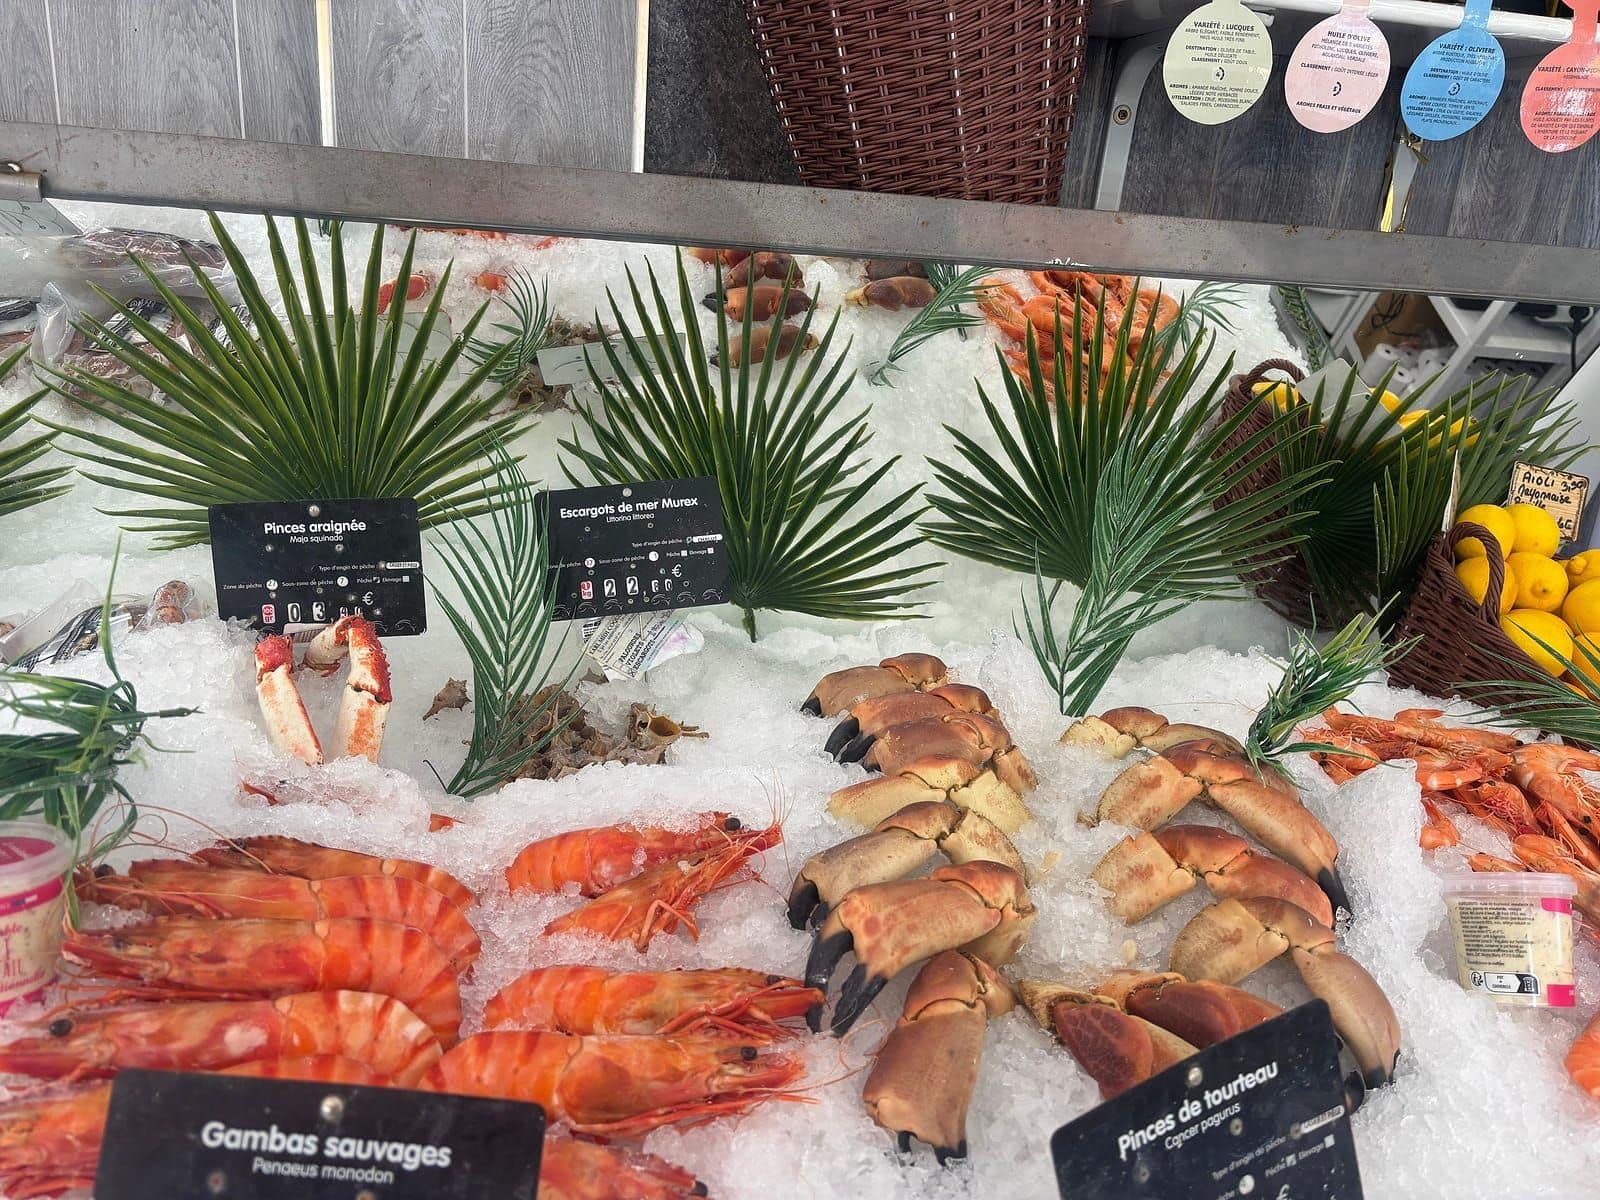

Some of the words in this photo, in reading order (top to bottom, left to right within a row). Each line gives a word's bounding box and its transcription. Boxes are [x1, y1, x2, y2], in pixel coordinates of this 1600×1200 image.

[1194, 21, 1220, 29] VARIÉTÉ
[1226, 24, 1255, 32] LUCQUES
[1328, 31, 1346, 39] HUILE
[1347, 34, 1371, 42] D'OLIVE
[1439, 43, 1464, 51] VARIÉTÉ
[1300, 62, 1331, 71] CLASSEMENT
[1522, 471, 1555, 487] AIOLI
[560, 503, 615, 520] Escargots
[617, 501, 633, 515] de
[636, 500, 658, 512] mer
[661, 497, 699, 510] Murex
[606, 514, 631, 523] Littorina
[632, 512, 655, 521] littorea
[264, 522, 306, 535] Pinces
[308, 518, 366, 535] araignée
[290, 535, 309, 544] Maja
[310, 534, 344, 544] squinado
[319, 564, 331, 572] Type
[672, 563, 682, 578] €
[223, 583, 237, 591] Zone
[309, 578, 317, 586] de
[317, 577, 334, 587] pêche
[362, 590, 374, 606] €
[1117, 1113, 1177, 1162] Pinces
[1178, 1098, 1202, 1123] de
[1203, 1061, 1279, 1109] tourteau
[1164, 1122, 1200, 1150] Cancer
[1200, 1102, 1241, 1134] pagurus
[201, 1120, 319, 1156] Gambas
[322, 1135, 453, 1172] sauvages
[1212, 1165, 1229, 1181] Type
[1255, 1146, 1265, 1157] de
[1265, 1136, 1286, 1152] pêche
[252, 1156, 319, 1179] Penaeus
[321, 1165, 395, 1185] monodon
